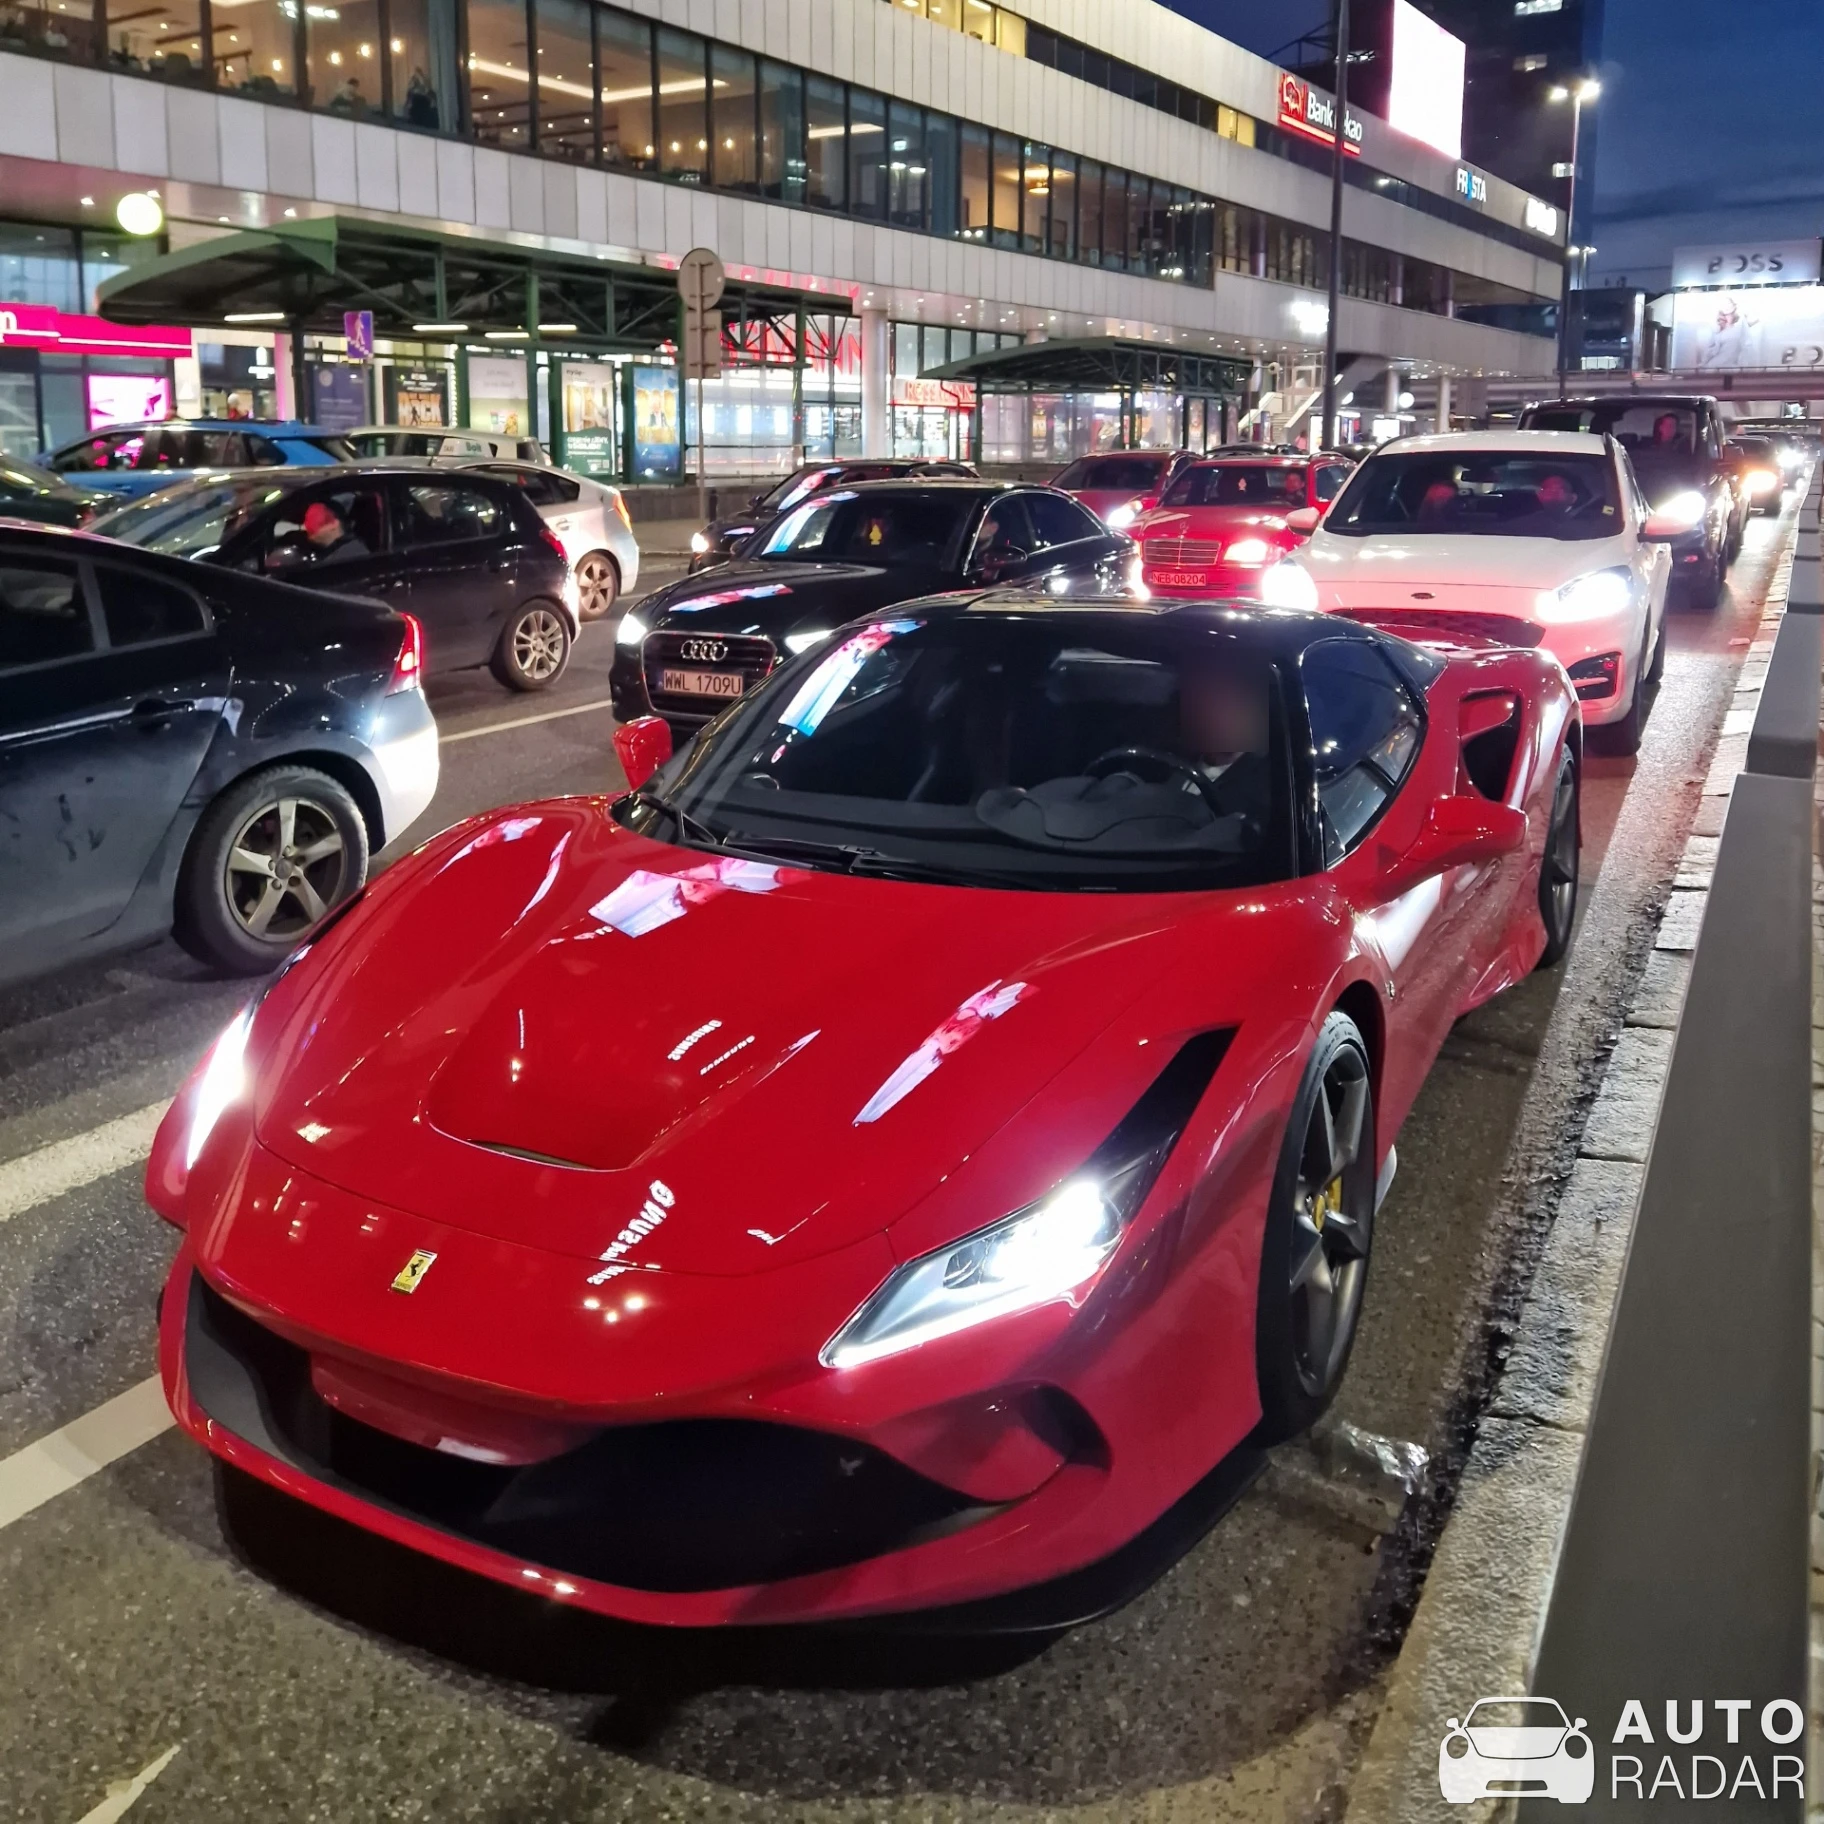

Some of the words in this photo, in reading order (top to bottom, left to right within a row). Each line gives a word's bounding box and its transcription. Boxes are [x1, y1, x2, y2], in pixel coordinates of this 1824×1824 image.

[1307, 92, 1333, 128] Bank
[1334, 109, 1363, 142] kao
[1708, 253, 1783, 274] BOSS
[465, 441, 482, 452] Bolt
[1152, 573, 1172, 583] NEB
[1174, 573, 1206, 584] 08204
[665, 673, 690, 691] WWL
[697, 676, 741, 694] 1709U
